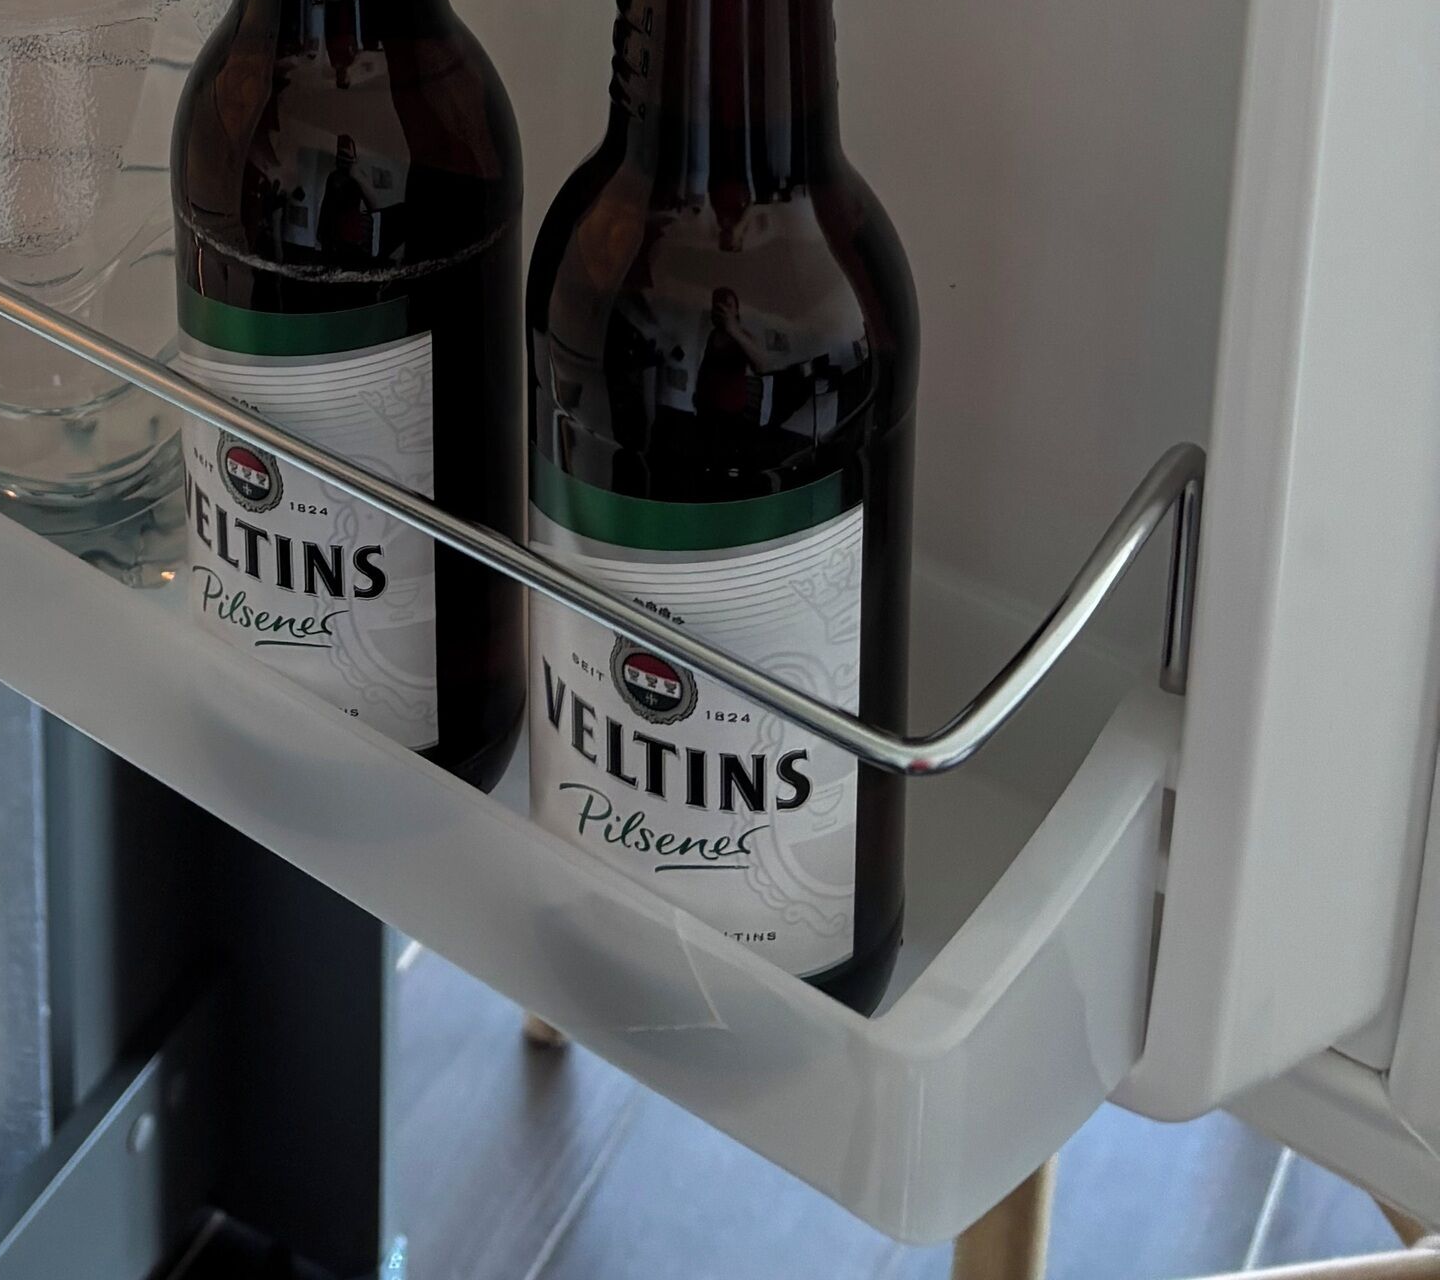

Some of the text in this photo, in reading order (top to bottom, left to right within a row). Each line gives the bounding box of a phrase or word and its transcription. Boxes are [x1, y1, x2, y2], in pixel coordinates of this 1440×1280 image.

[184, 459, 389, 601] VELTINS
[288, 500, 329, 517] 1824
[192, 565, 350, 640] Pilsener
[571, 651, 752, 724] SEIT 1824
[542, 654, 814, 814] VELTINS
[559, 781, 771, 862] Pilsener
